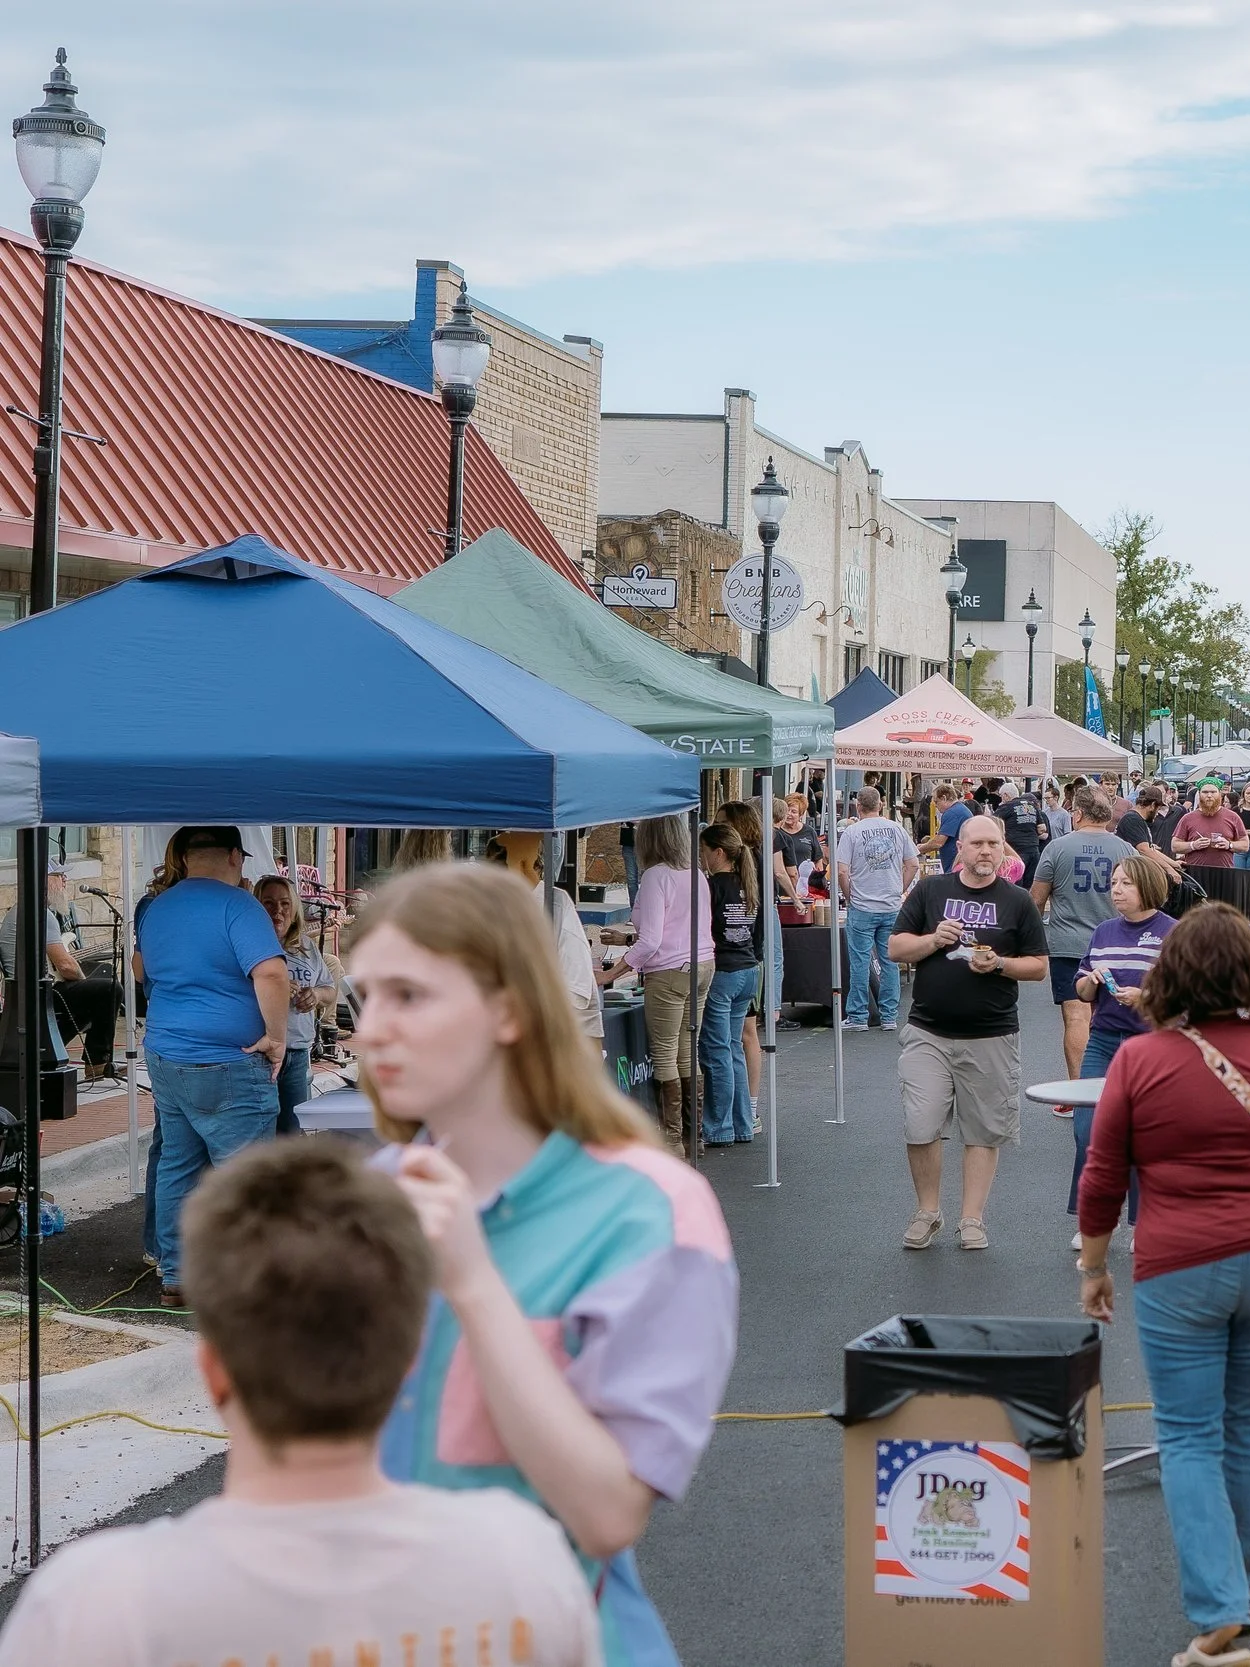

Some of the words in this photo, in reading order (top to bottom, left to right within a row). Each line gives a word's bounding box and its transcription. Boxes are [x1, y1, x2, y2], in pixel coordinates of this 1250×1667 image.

[612, 585, 667, 596] Homeward
[725, 579, 801, 599] Creaions
[883, 711, 928, 724] CROSS
[935, 711, 980, 728] CREEK
[855, 748, 877, 756] WRAPS
[880, 749, 900, 757] SOUPS
[903, 750, 925, 758] SALADS
[928, 751, 955, 759] CATERING
[958, 752, 991, 761] BREAKFAST
[994, 754, 1013, 763] ROOM
[1014, 756, 1039, 765] RENTALS
[858, 758, 877, 767] CAKES
[880, 760, 894, 768] PIES
[897, 760, 913, 768] BARS
[916, 761, 937, 769] WHOLE
[938, 762, 967, 771] DESSERTS
[970, 763, 995, 772] DESSERT
[996, 765, 1023, 774] CATERING
[1082, 844, 1105, 855] DEAL
[1073, 856, 1113, 893] 53
[943, 898, 998, 925] UCA
[916, 1473, 986, 1501] JDog
